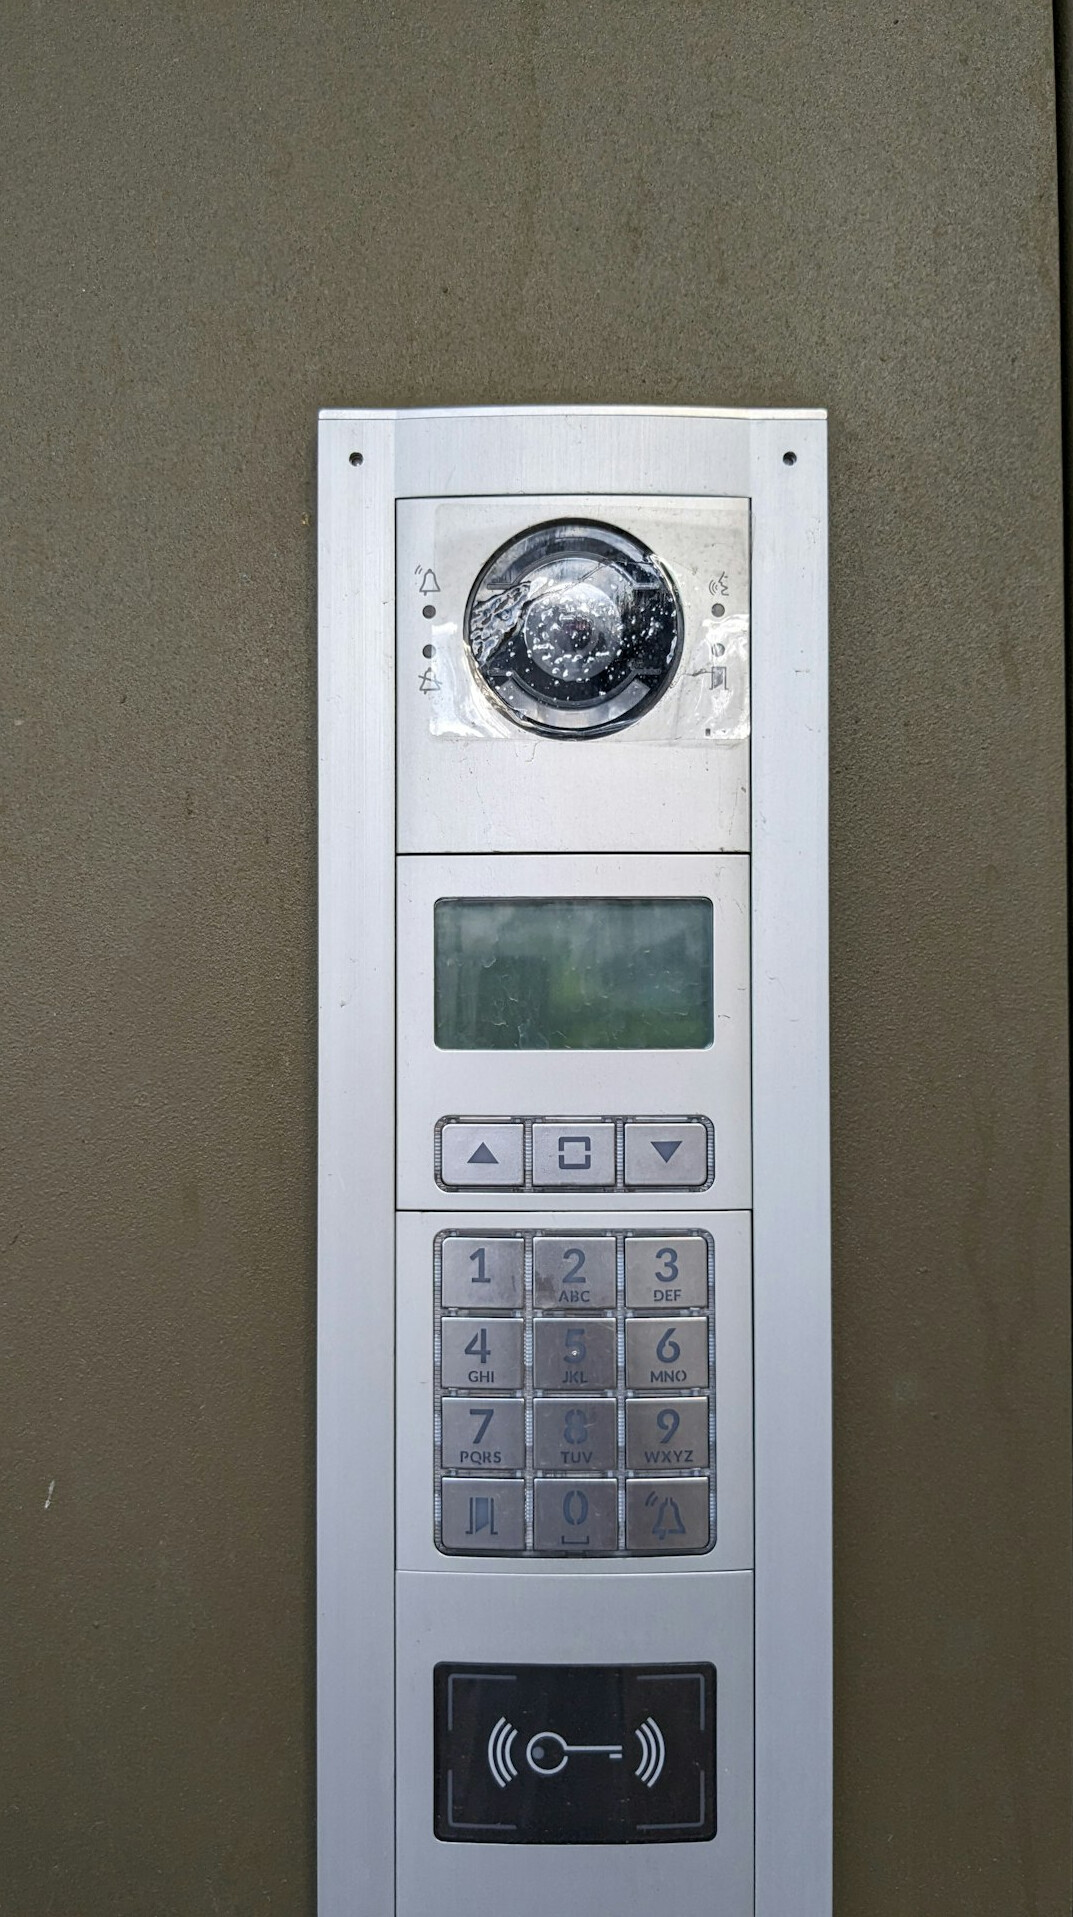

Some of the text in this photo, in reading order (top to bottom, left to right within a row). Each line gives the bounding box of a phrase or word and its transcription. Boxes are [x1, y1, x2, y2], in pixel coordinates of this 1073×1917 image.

[469, 1248, 491, 1283] 1
[562, 1248, 586, 1283] 2
[655, 1248, 678, 1282] 3
[559, 1290, 590, 1302] ABC
[654, 1290, 682, 1302] DEF
[465, 1329, 491, 1363] 4
[564, 1329, 586, 1364] 5
[656, 1328, 680, 1363] 6
[468, 1371, 494, 1383] GHI
[562, 1371, 588, 1384] JKL
[651, 1370, 686, 1382] MNO
[469, 1409, 494, 1443] 7
[564, 1409, 588, 1444] 8
[657, 1409, 680, 1443] 9
[460, 1451, 501, 1464] PQRS
[561, 1451, 592, 1464] TUV
[645, 1451, 693, 1463] WXYZ
[563, 1490, 588, 1525] 0
